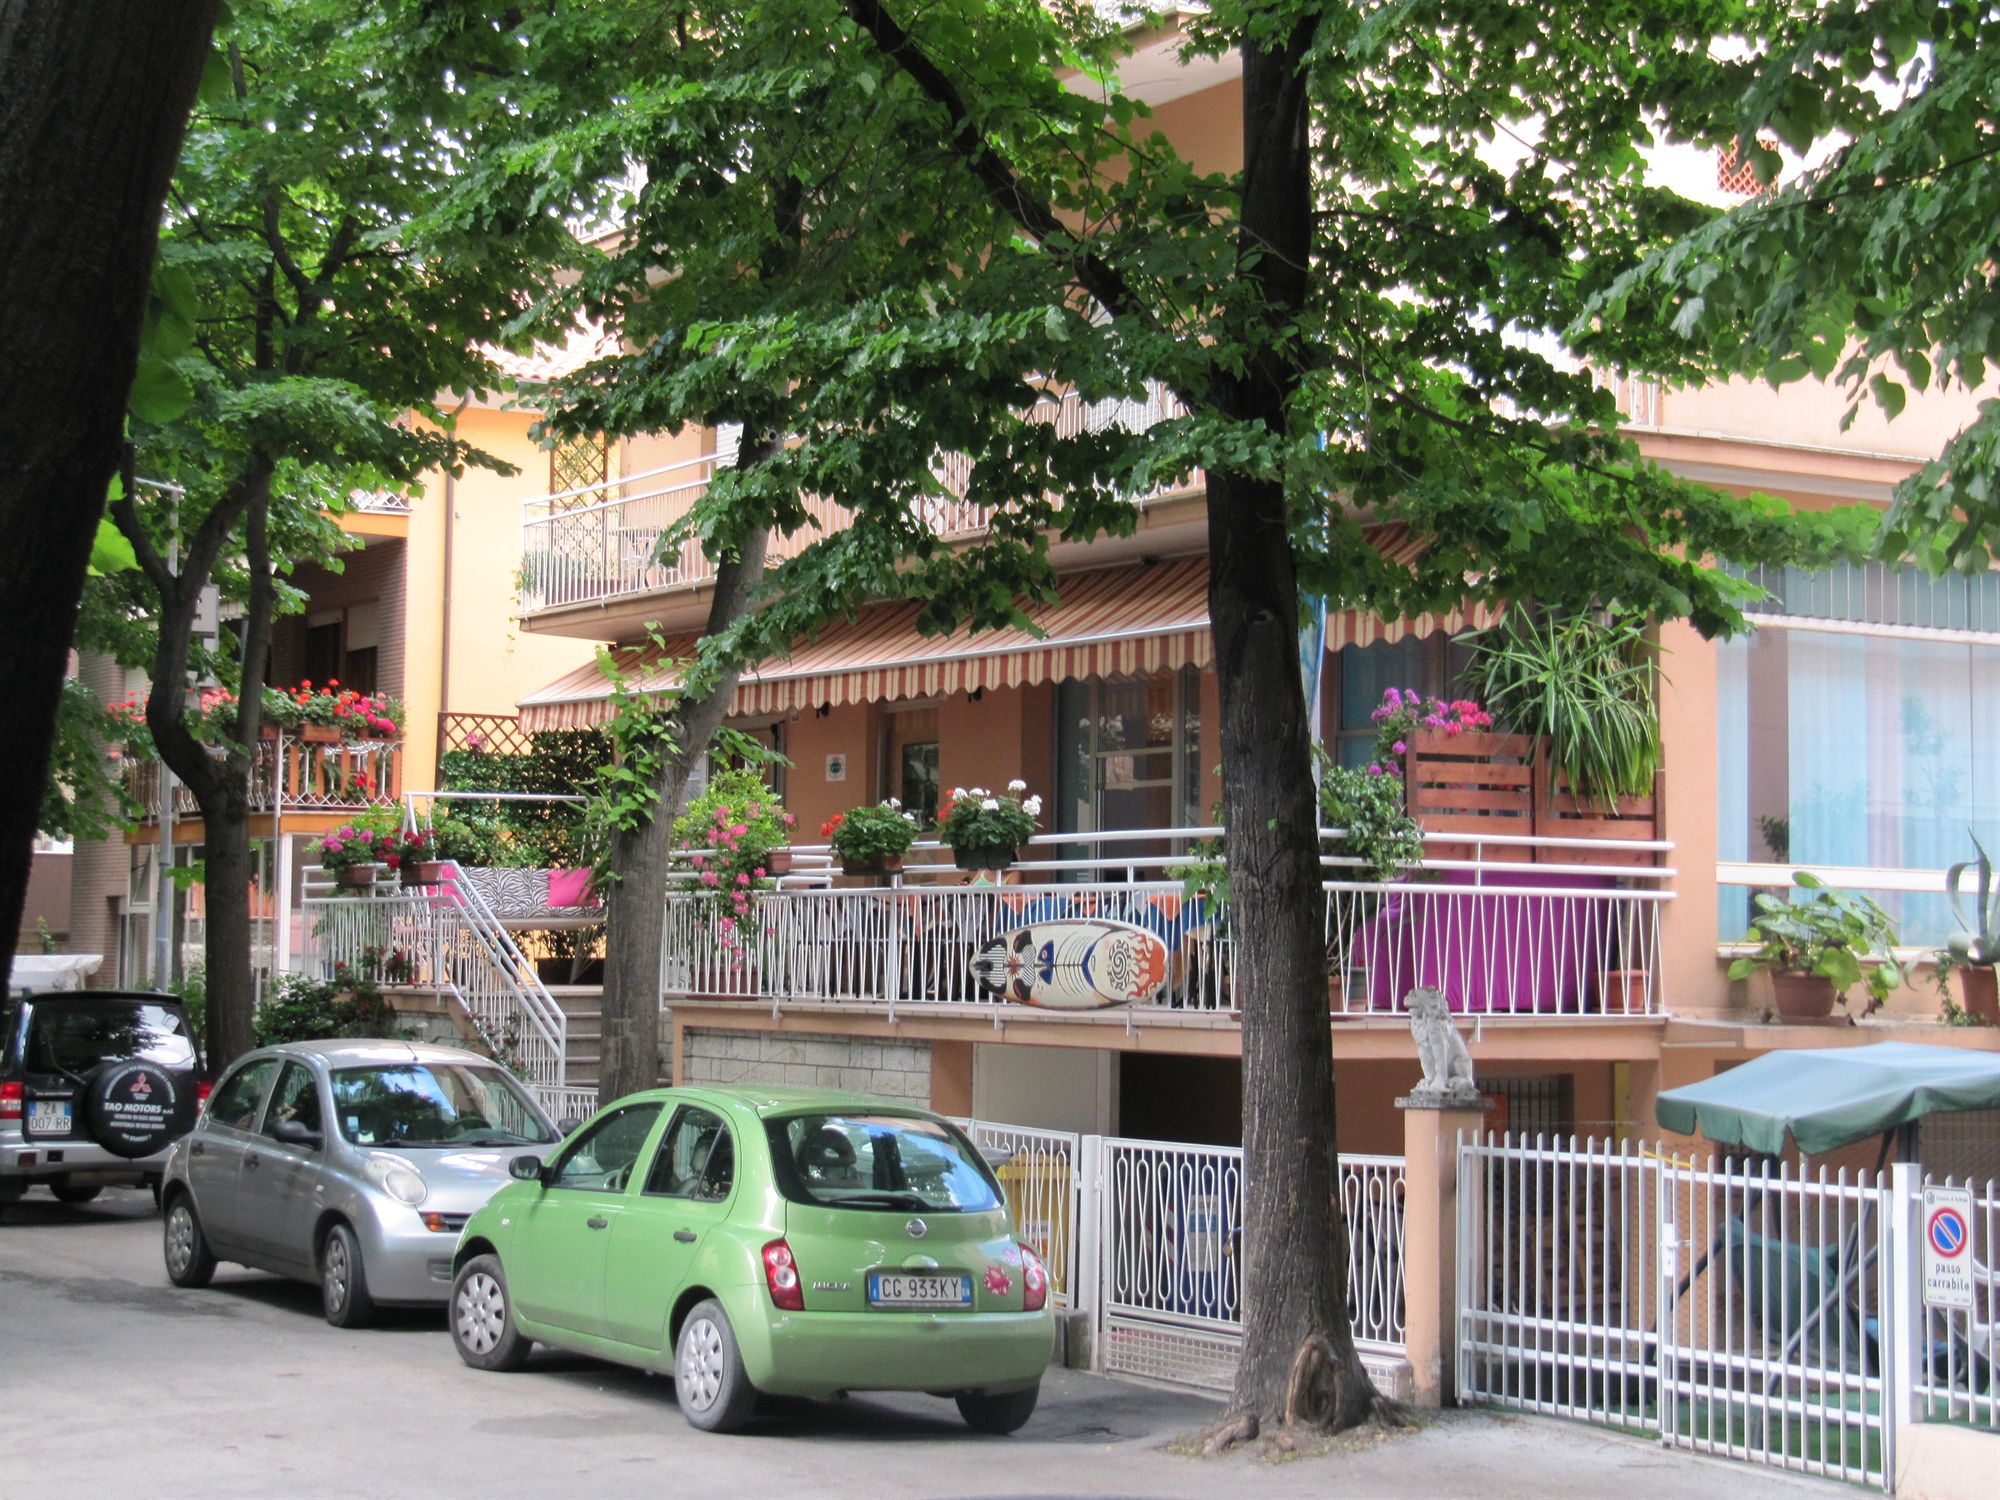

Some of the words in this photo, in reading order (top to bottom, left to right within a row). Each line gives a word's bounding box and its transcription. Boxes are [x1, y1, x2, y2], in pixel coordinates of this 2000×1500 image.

[104, 1102, 122, 1112] TAO
[123, 1103, 161, 1113] MOTORS
[31, 1117, 51, 1130] 007
[56, 1117, 70, 1130] RR
[1935, 1263, 1961, 1275] passo
[882, 1278, 902, 1298] CG
[908, 1278, 959, 1298] 933KY
[1927, 1277, 1970, 1291] carrabile
